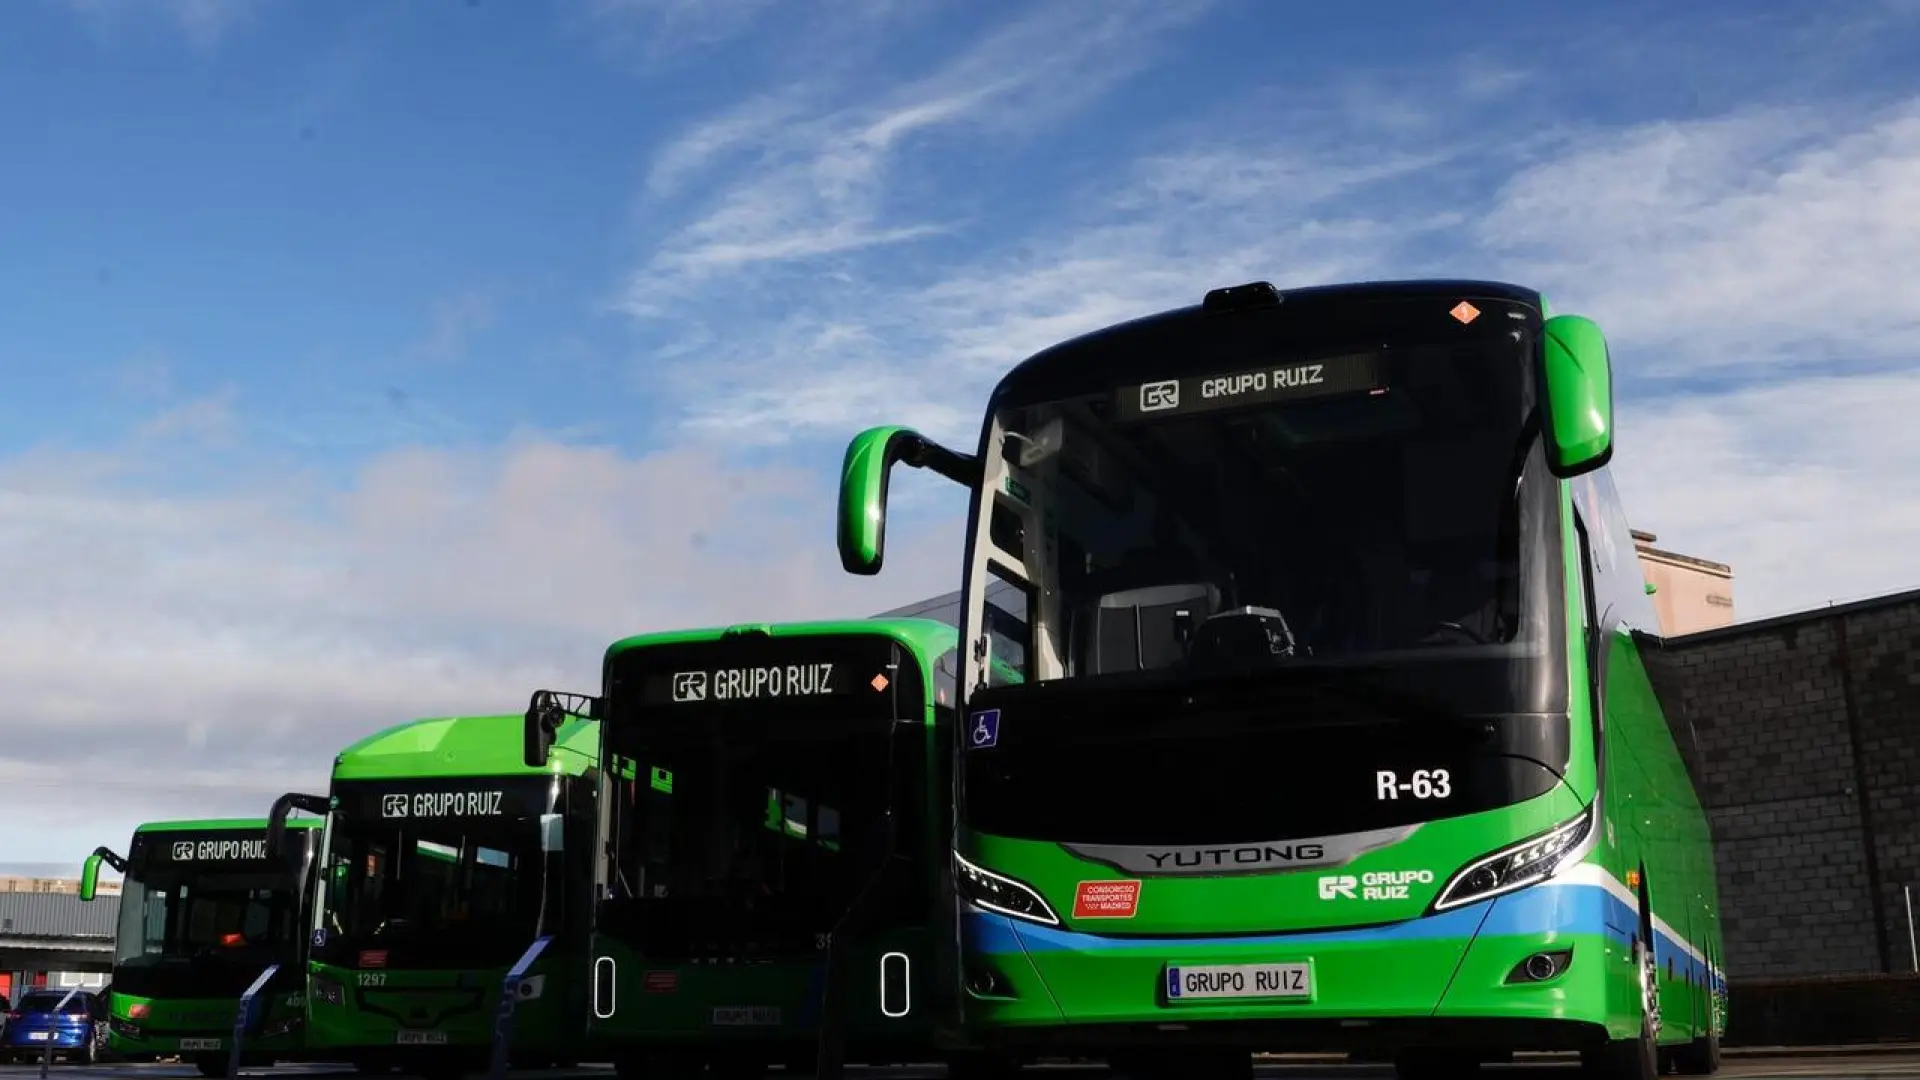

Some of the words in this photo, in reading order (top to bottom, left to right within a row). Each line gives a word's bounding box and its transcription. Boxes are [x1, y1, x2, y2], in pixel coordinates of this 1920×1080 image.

[1202, 372, 1267, 398] GRUPO
[1273, 365, 1324, 389] RUIZ
[714, 666, 781, 699] GRUPO
[786, 664, 833, 695] RUIZ
[1377, 769, 1451, 800] R-63
[413, 792, 465, 817] GRUPO
[467, 791, 502, 815] RUIZ
[198, 840, 239, 860] GRUPO
[241, 840, 266, 859] RUIZ
[1146, 844, 1324, 868] YUTONG
[1362, 869, 1434, 886] GRUPO
[1083, 894, 1133, 902] TRANSPORTES
[1087, 885, 1134, 894] CONSORCIO
[1362, 885, 1409, 900] RUIZ
[357, 972, 387, 986] 1297
[1186, 972, 1244, 992] GRUPO
[1256, 970, 1304, 990] RUIZ
